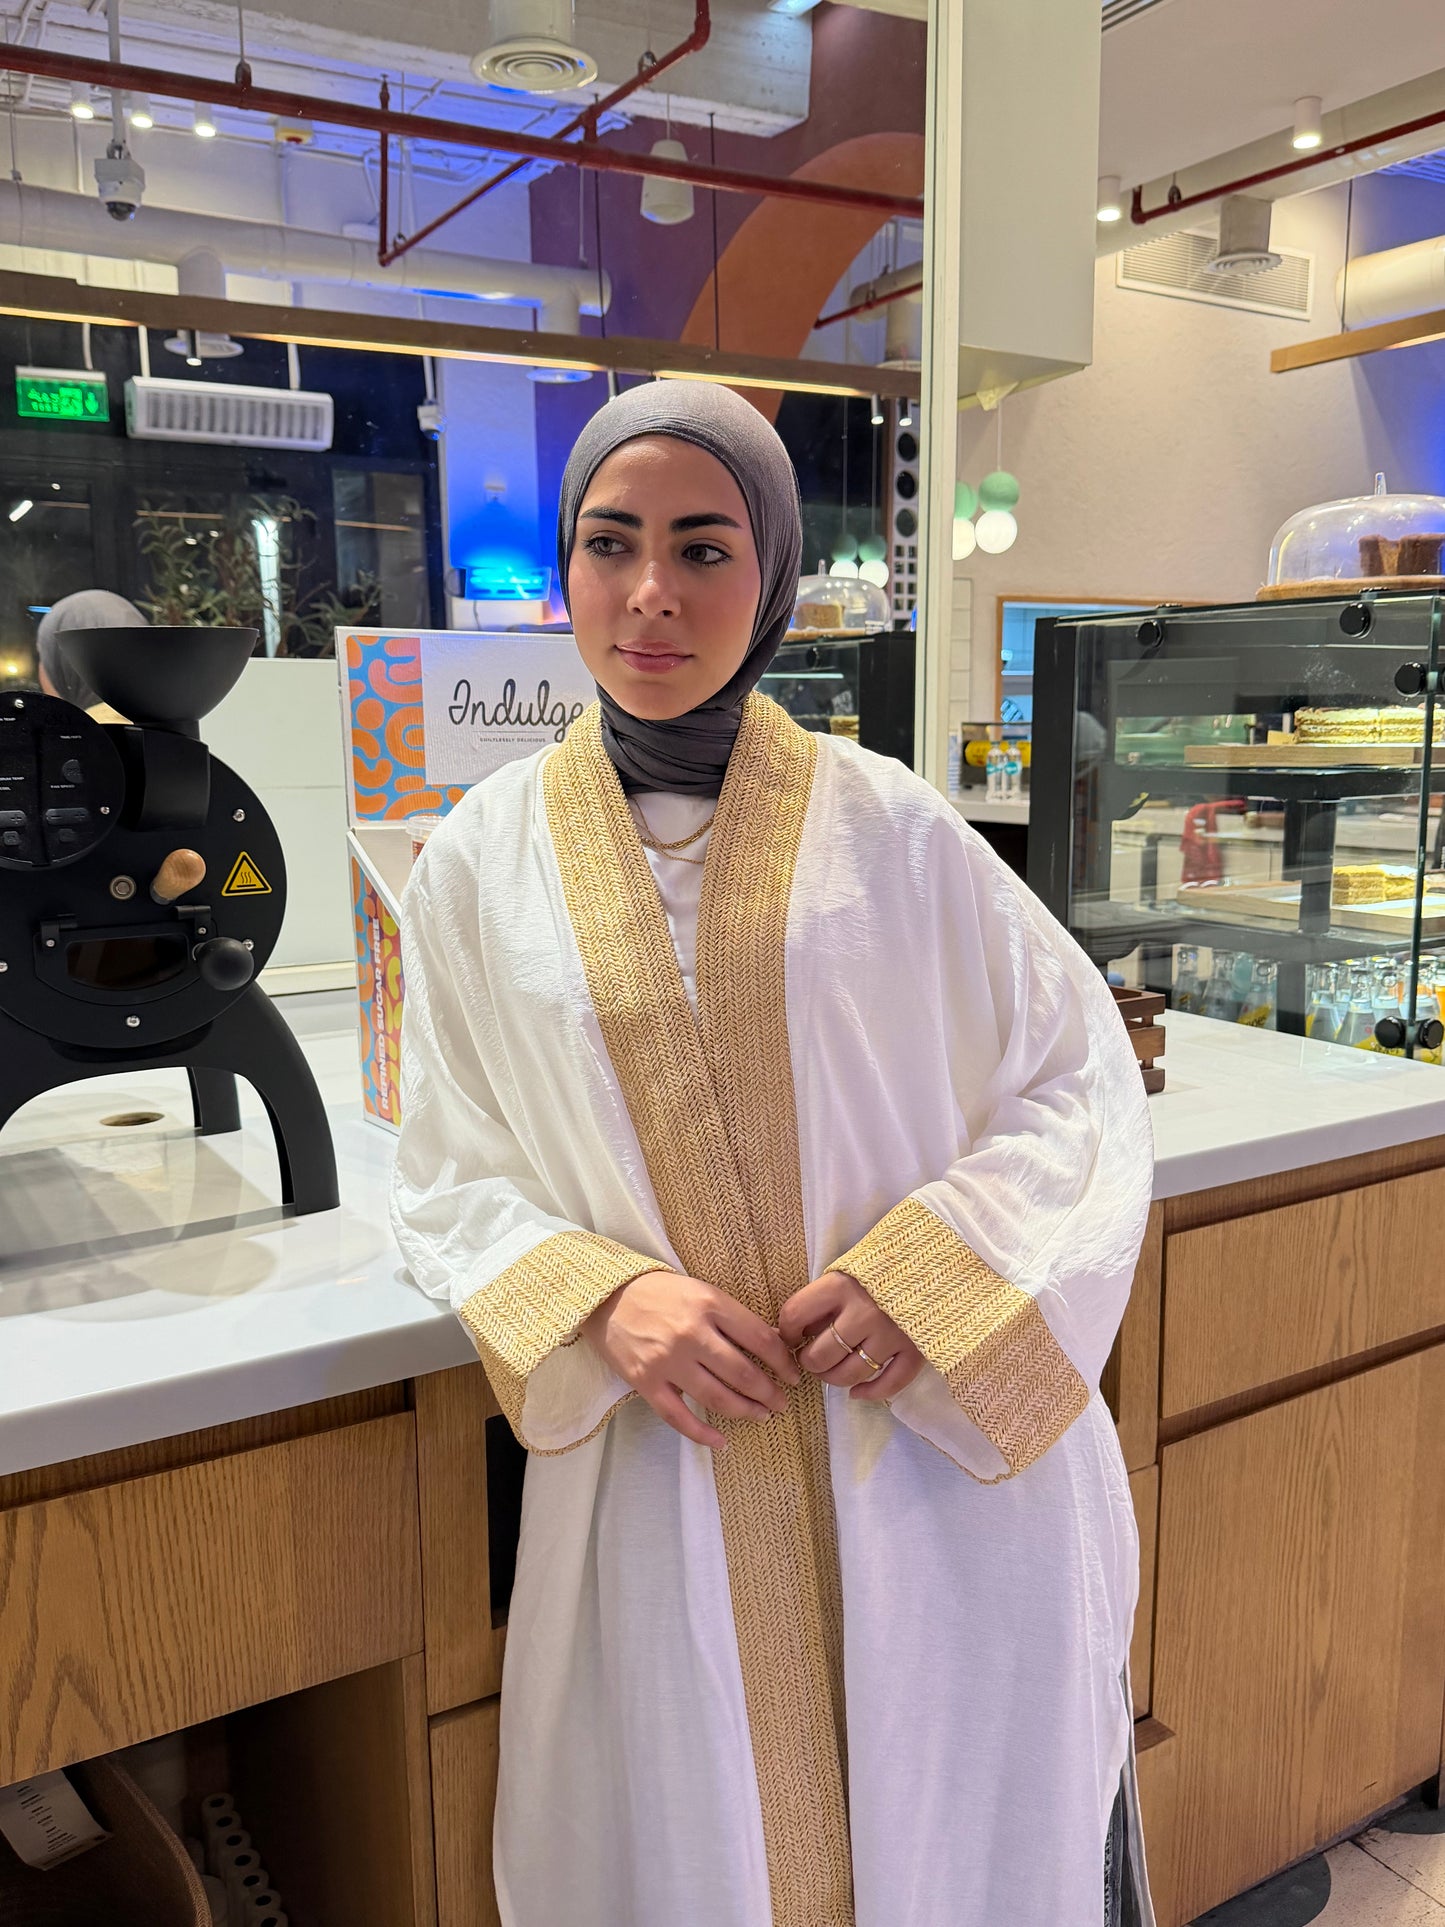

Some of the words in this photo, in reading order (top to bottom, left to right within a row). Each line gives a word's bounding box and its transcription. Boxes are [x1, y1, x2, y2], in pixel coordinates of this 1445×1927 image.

[448, 679, 583, 743] Indulge
[372, 918, 381, 964] FREE
[374, 967, 384, 1031] SUGAR
[377, 1032, 389, 1109] REFINED
